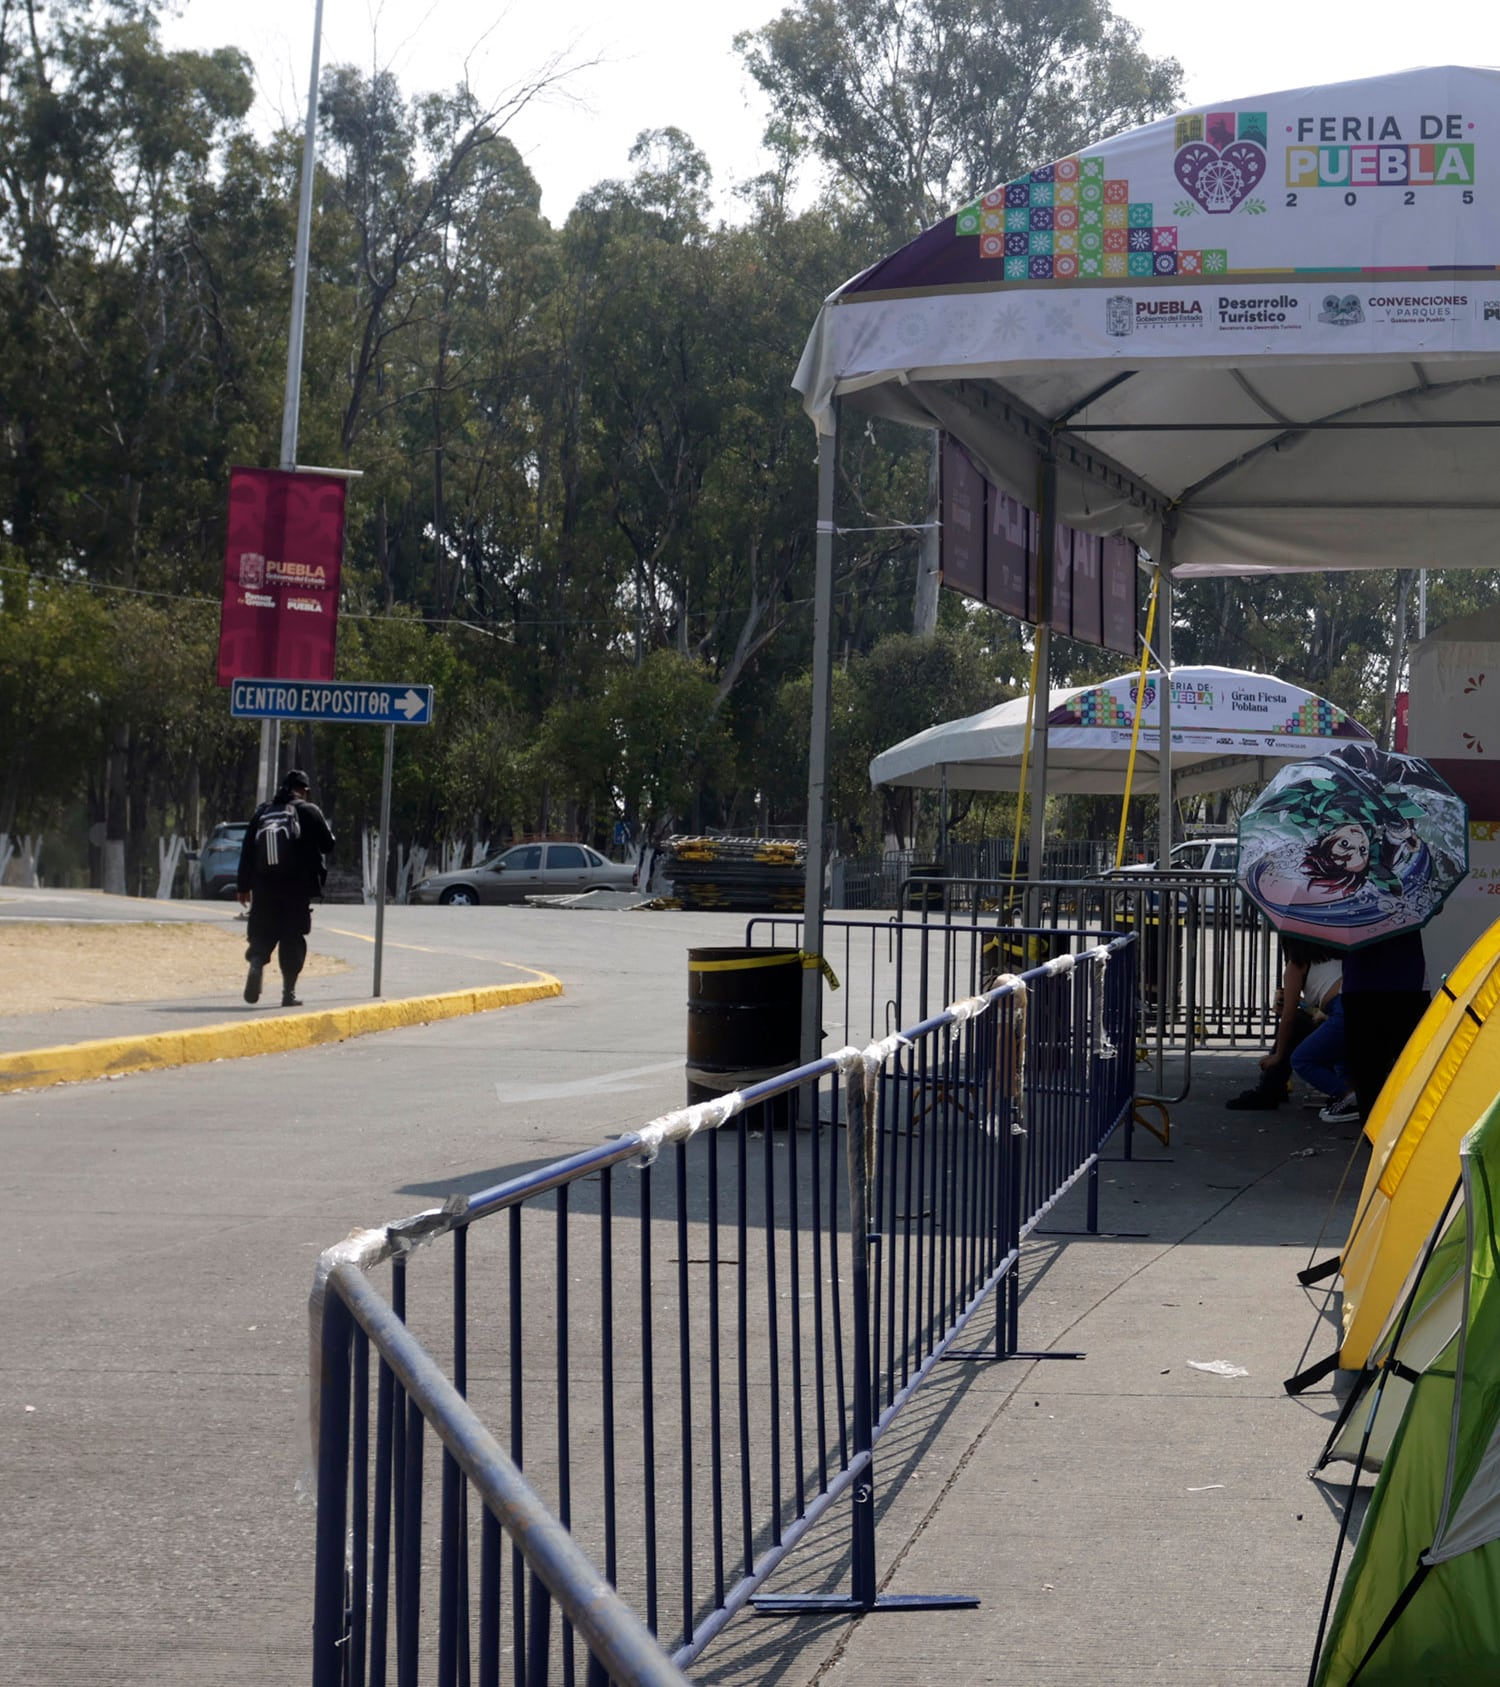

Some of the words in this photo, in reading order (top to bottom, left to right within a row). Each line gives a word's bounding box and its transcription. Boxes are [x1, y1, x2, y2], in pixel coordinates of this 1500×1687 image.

[1298, 116, 1402, 142] FERIA
[1420, 115, 1462, 140] DE
[1288, 145, 1472, 185] PUEBLA
[1136, 301, 1202, 315] PUEBLA
[1218, 295, 1298, 309] Desarrollo
[1368, 296, 1468, 307] CONVENCIONES
[1219, 310, 1286, 323] Turístico
[1385, 308, 1391, 316] Y
[1397, 307, 1451, 317] PARQUES
[266, 561, 325, 578] PUEBLA
[1170, 681, 1193, 691] ERIA
[1197, 682, 1209, 692] DE
[235, 686, 298, 711] CENTRO
[301, 689, 390, 715] EXPOSITOR
[1171, 691, 1213, 704] UEBLA
[1231, 691, 1256, 701] Gran
[1258, 692, 1287, 703] Fiesta
[1232, 701, 1268, 712] Poblana
[1472, 867, 1487, 879] 24
